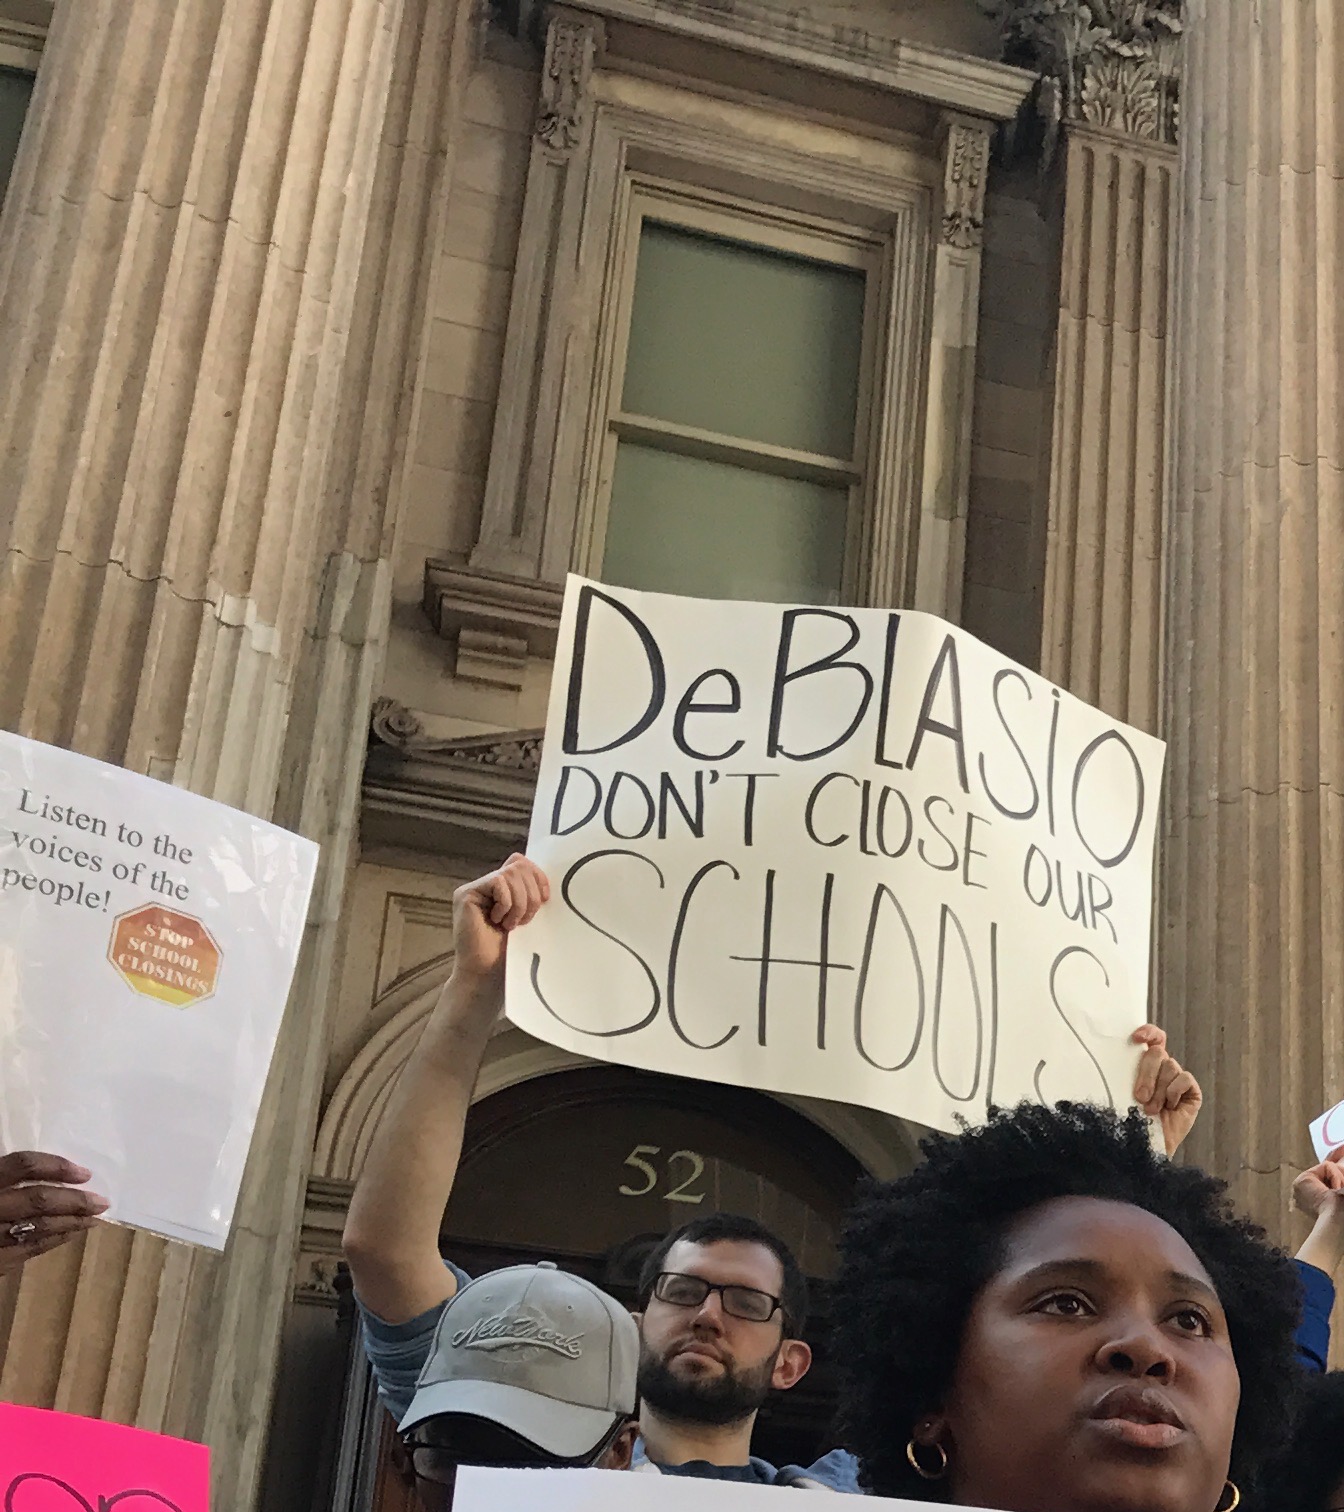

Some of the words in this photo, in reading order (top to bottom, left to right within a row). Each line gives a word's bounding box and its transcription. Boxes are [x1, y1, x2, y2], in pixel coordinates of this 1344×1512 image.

[17, 789, 107, 837] Listen
[118, 823, 143, 848] to
[153, 834, 193, 865] the
[550, 765, 779, 845] DON'T
[805, 772, 991, 889] CLOSE
[1023, 844, 1118, 944] OUR
[2, 867, 111, 913] people!
[12, 831, 103, 872] voices
[112, 862, 147, 885] of
[150, 870, 190, 901] the
[128, 937, 201, 974] SCHOOL
[144, 923, 194, 949] STOP
[118, 953, 209, 994] CLOSINGS
[532, 849, 1114, 1108] SCHOOLS
[619, 1145, 706, 1204] 52
